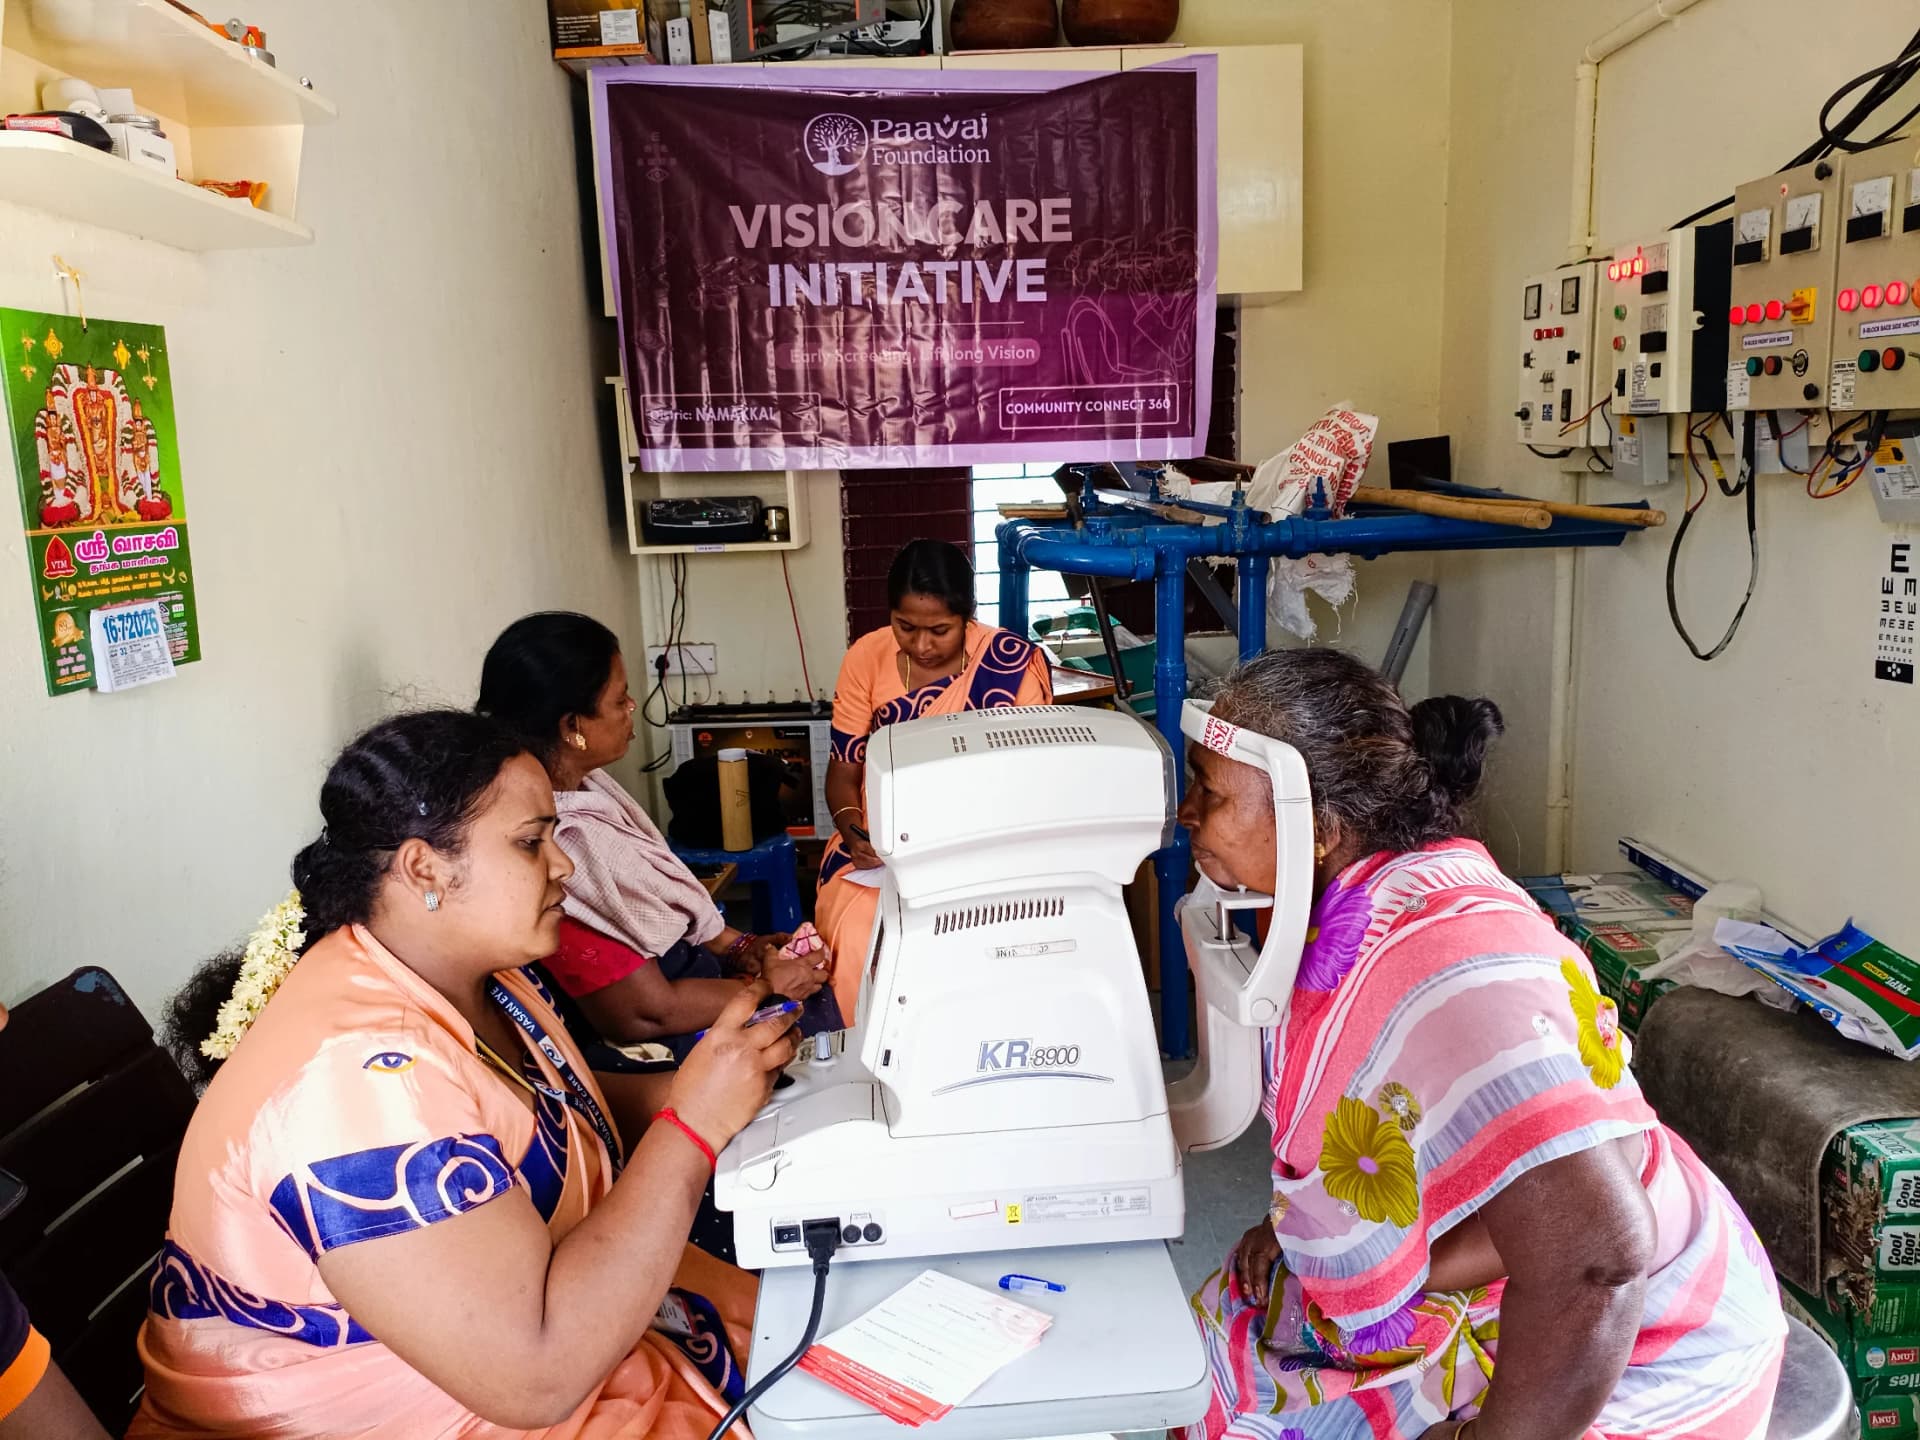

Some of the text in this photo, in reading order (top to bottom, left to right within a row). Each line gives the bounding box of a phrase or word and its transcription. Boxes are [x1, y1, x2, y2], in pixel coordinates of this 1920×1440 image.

[871, 113, 988, 142] Paavai
[872, 144, 991, 166] Foundation
[728, 198, 1073, 248] VISION CARE
[768, 258, 1047, 307] INITIATIVE
[988, 345, 1035, 361] Vision
[695, 407, 776, 422] NAMAKKAL
[1006, 398, 1171, 414] COMMUNITY CONNECT 360
[1290, 453, 1328, 477] PHONE
[112, 527, 178, 555] வாசவி
[51, 560, 67, 570] VTM
[490, 986, 537, 1034] VASAN EYE
[567, 1072, 588, 1099] CARE
[1896, 1178, 1913, 1209] Cool
[1888, 1233, 1903, 1266] Cool
[1901, 1231, 1917, 1266] Roof
[1889, 1373, 1920, 1388] iles
